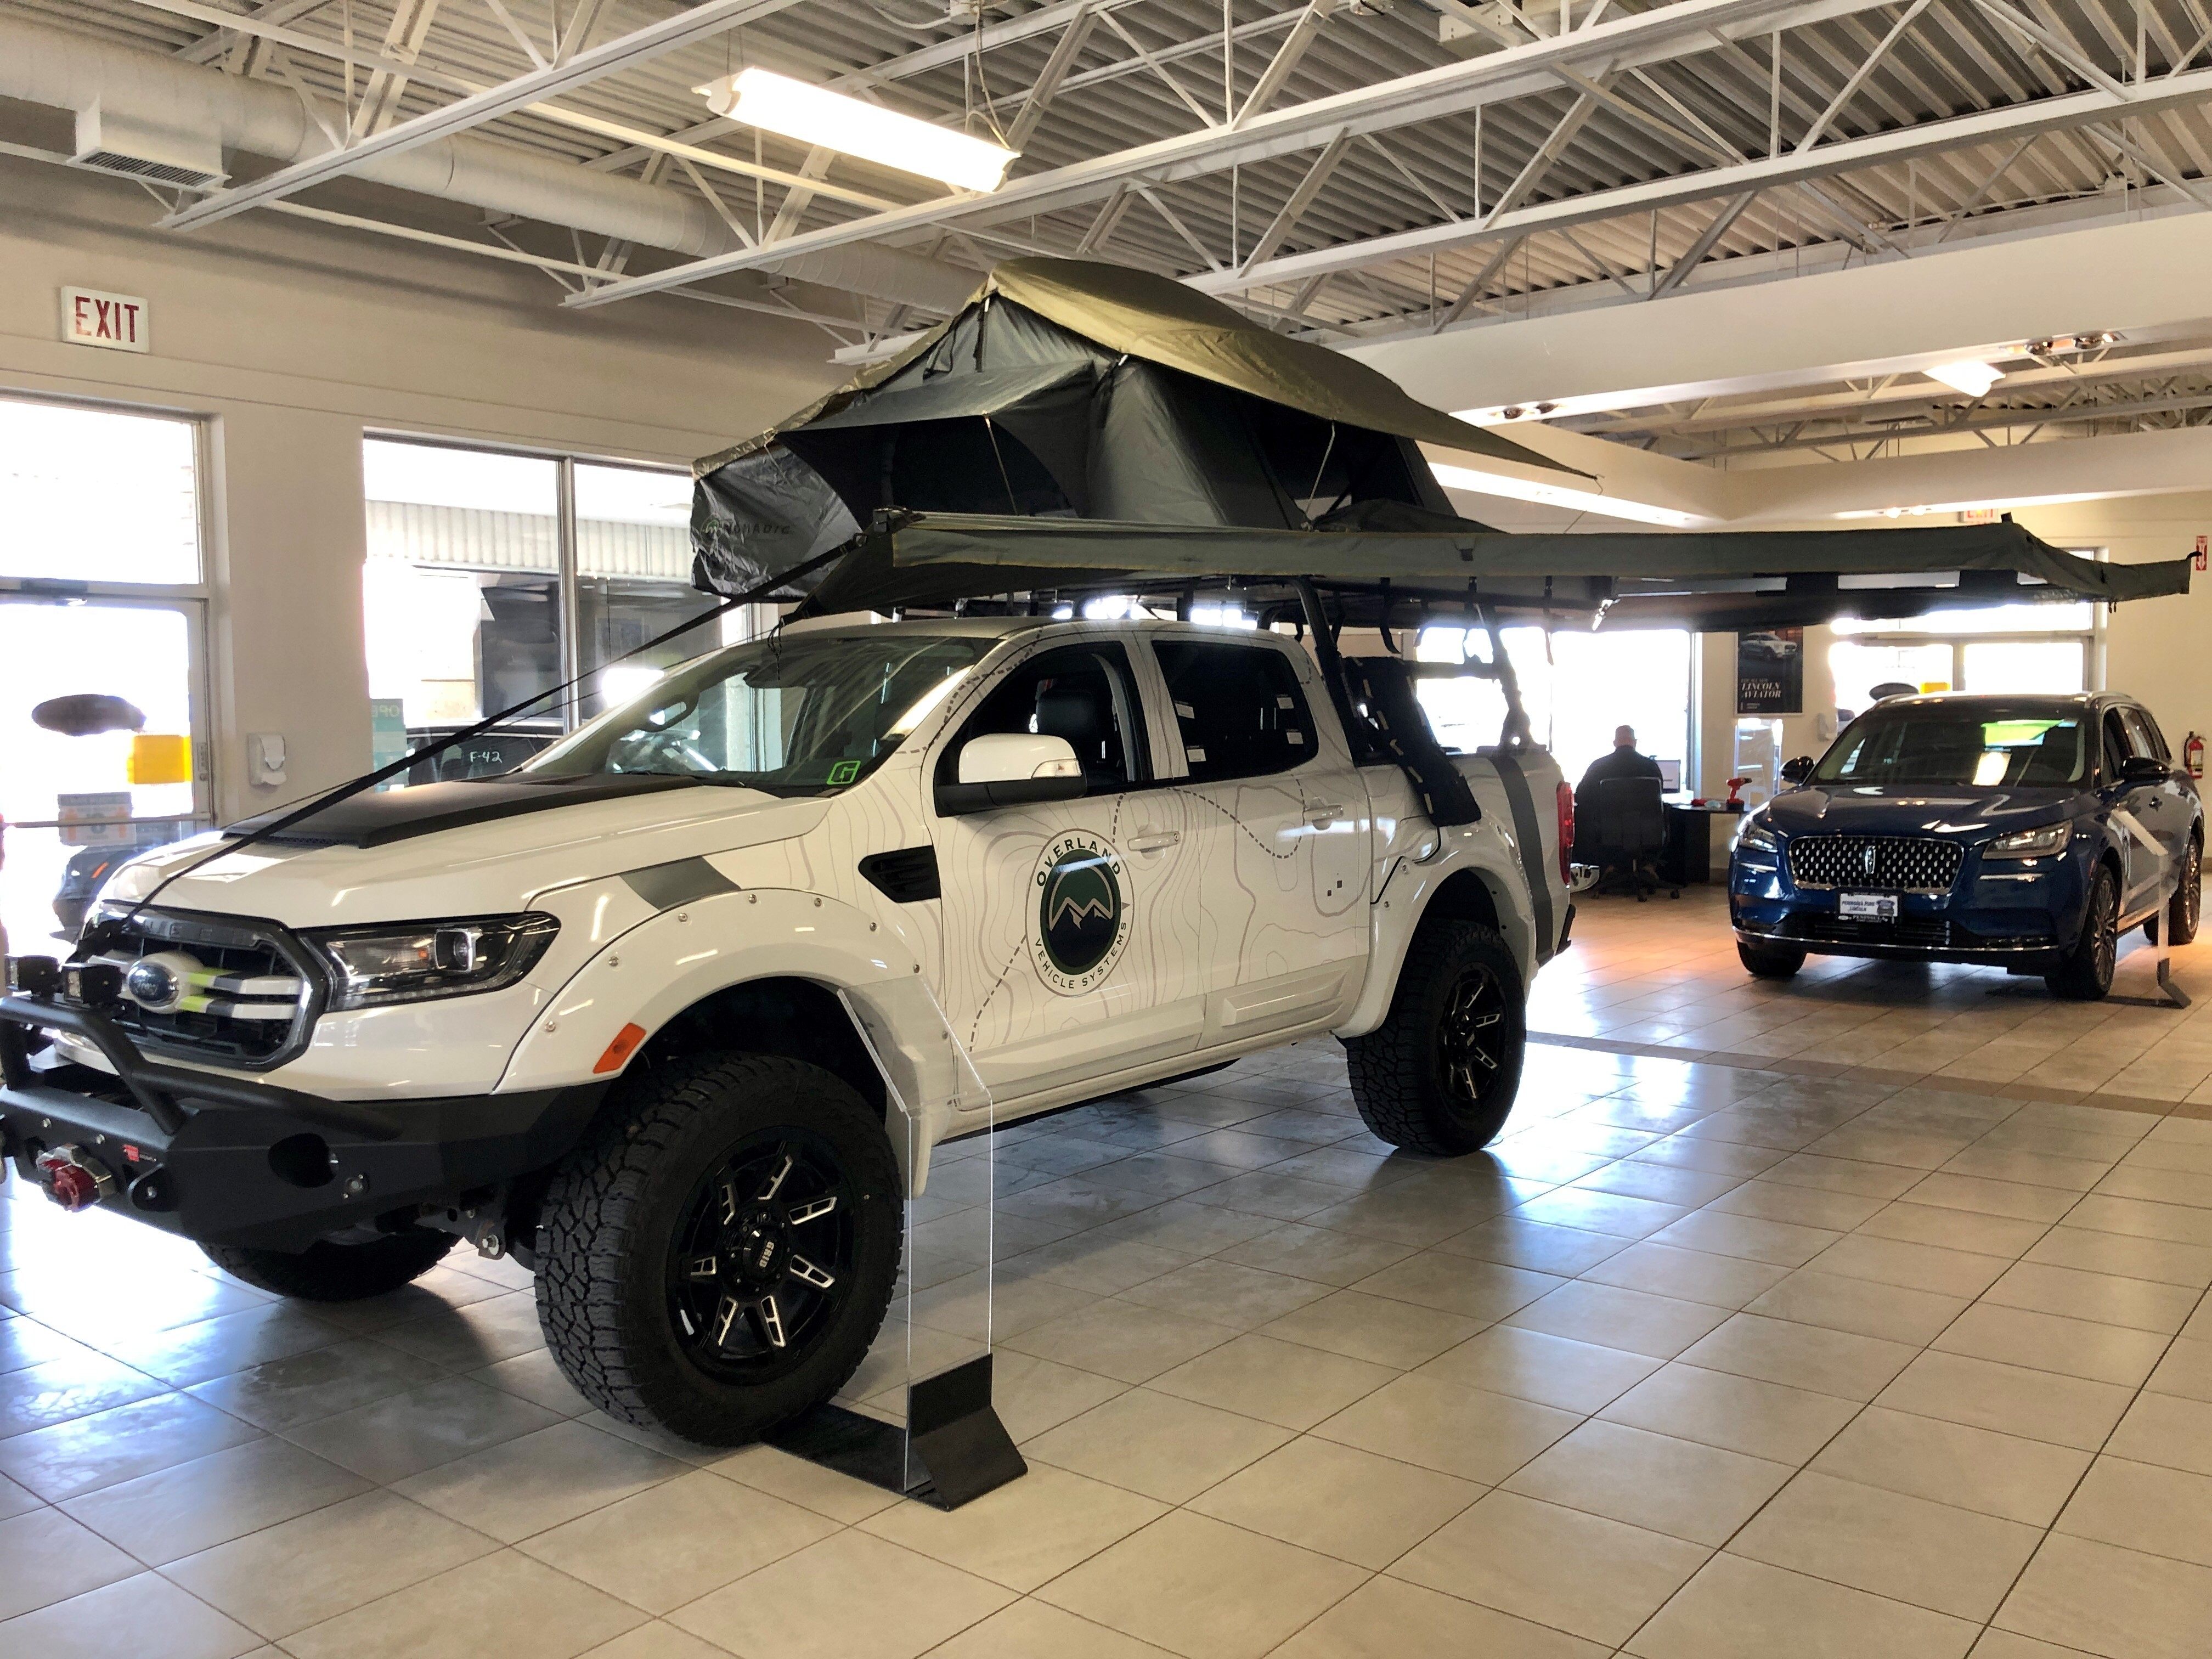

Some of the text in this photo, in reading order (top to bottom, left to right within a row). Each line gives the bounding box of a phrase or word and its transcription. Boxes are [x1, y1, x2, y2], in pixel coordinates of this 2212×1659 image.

[75, 296, 139, 342] EXIT
[1742, 682, 1781, 691] LINCOLN
[470, 751, 503, 763] F-42
[1036, 837, 1120, 887] OVERLAND
[1035, 922, 1127, 989] VEHICLE SYSTEMS
[759, 1241, 775, 1267] GRID
